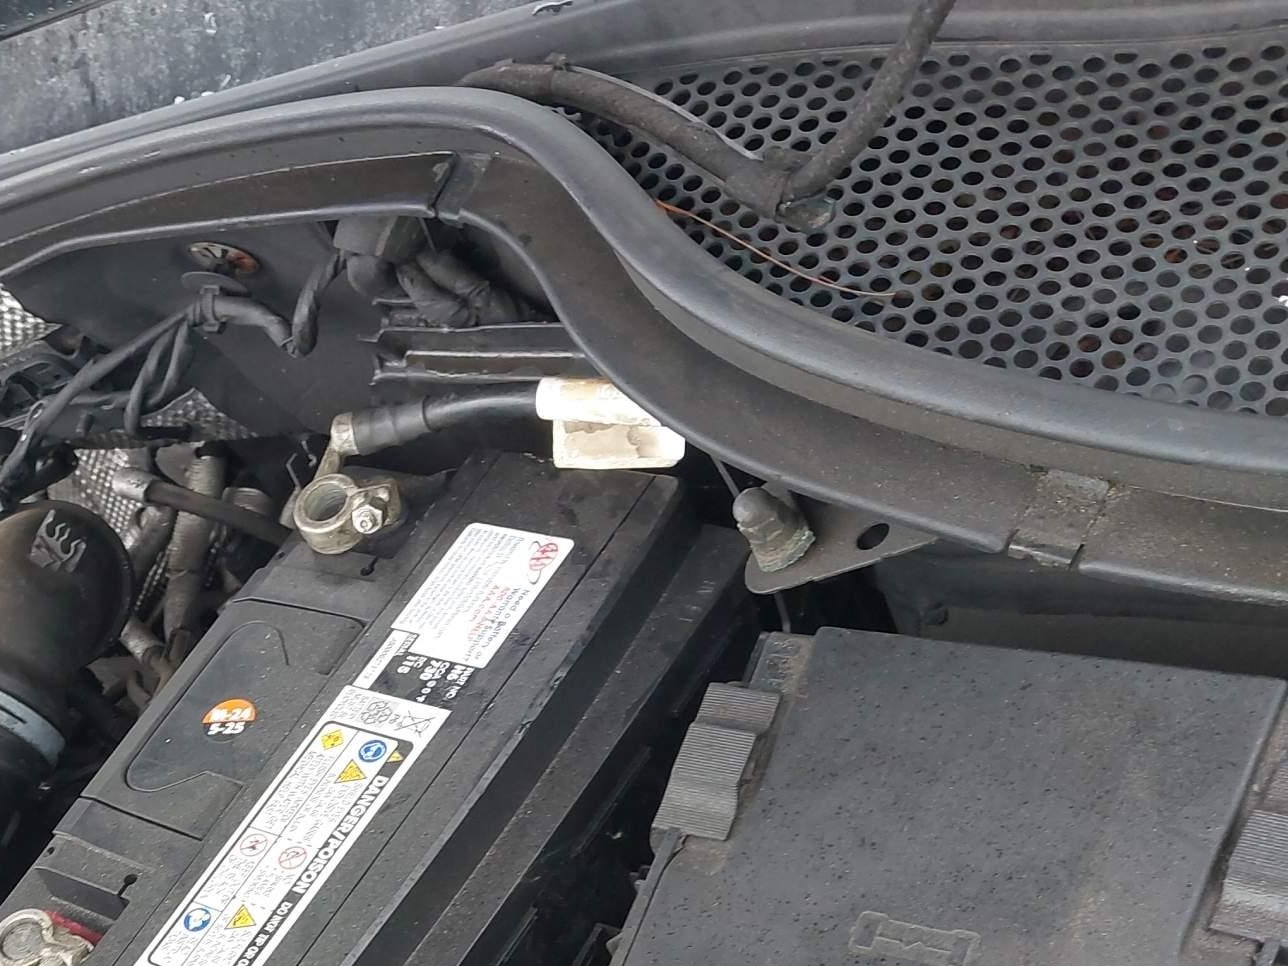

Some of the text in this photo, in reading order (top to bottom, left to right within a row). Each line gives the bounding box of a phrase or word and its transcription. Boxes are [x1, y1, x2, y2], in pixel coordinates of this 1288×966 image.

[487, 588, 521, 625] Warranty
[509, 589, 530, 612] Need
[481, 620, 507, 648] Battery
[431, 661, 450, 680] CCA
[293, 776, 388, 893] DANGER/POISON
[276, 901, 293, 916] DO
[264, 914, 283, 933] NOT
[254, 933, 270, 947] TIP
[243, 946, 259, 959] OR
